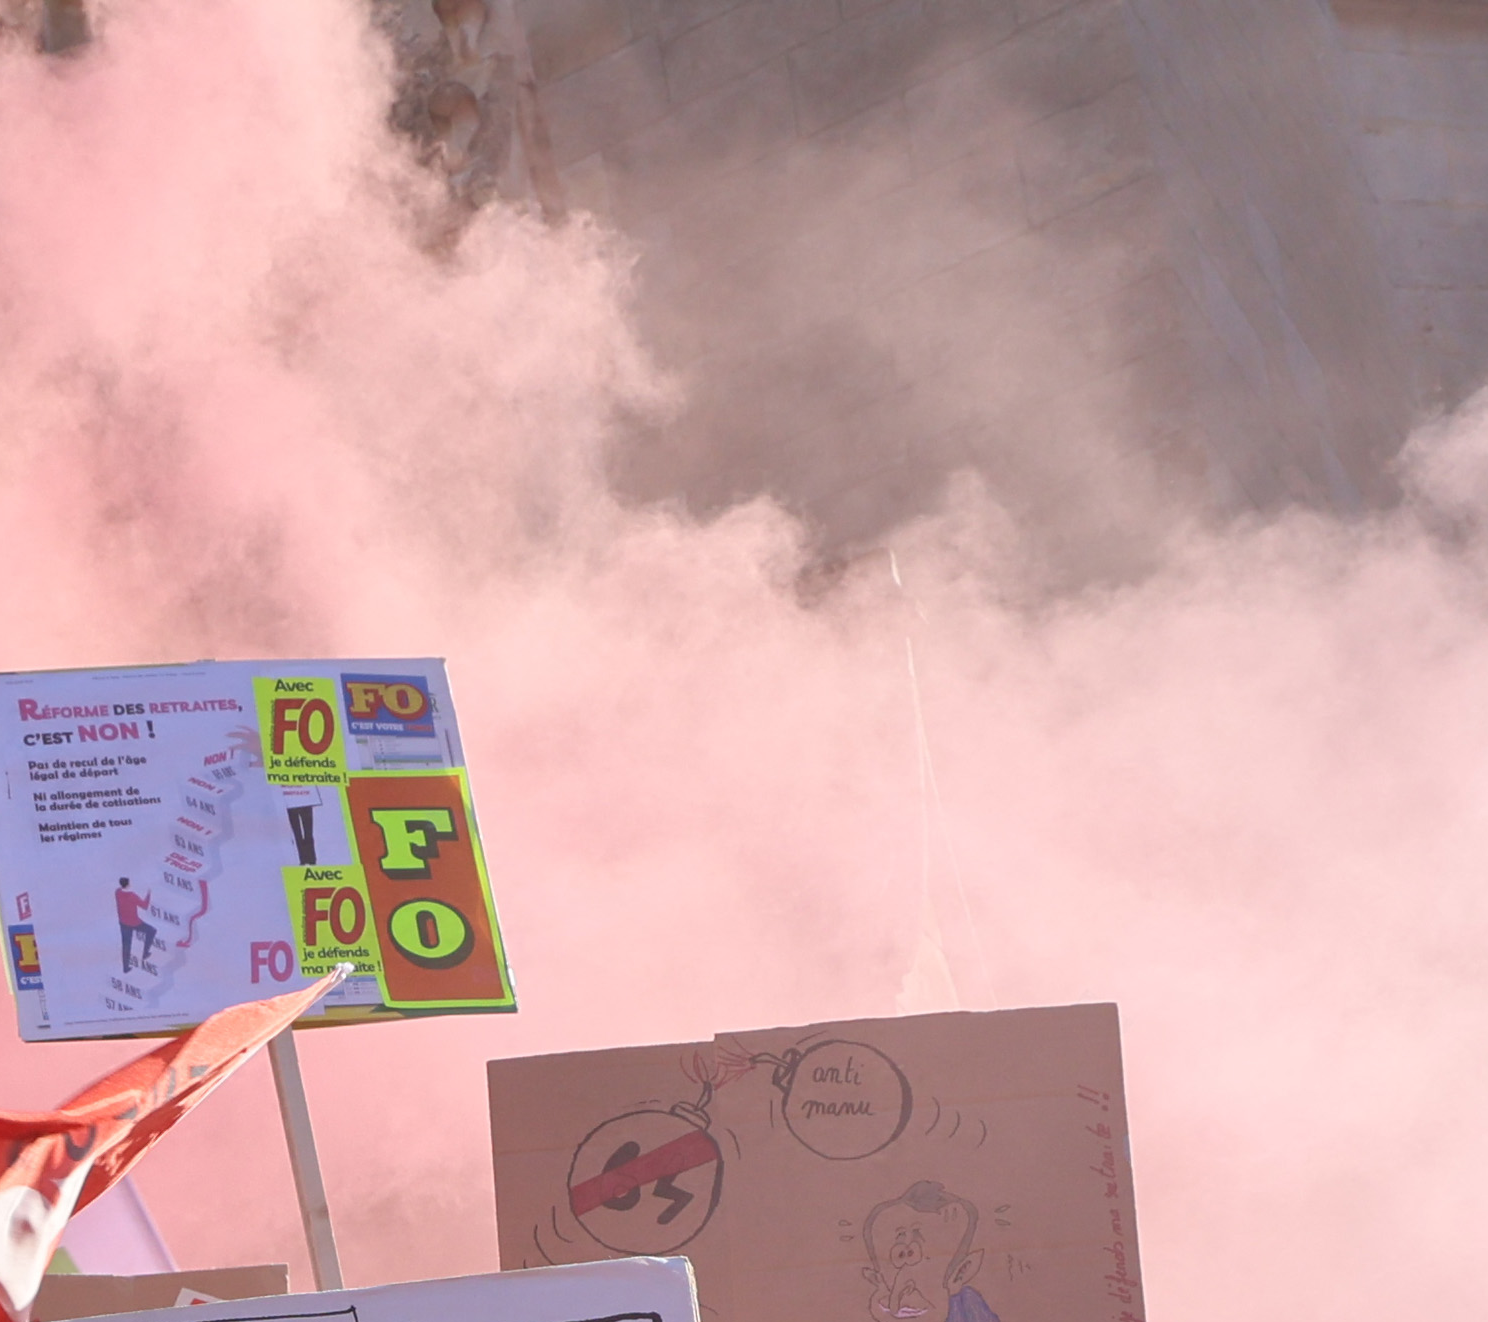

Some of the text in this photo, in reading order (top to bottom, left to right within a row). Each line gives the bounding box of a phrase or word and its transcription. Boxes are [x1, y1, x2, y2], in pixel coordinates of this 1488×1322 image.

[275, 679, 314, 692] Avec
[113, 703, 144, 715] DES
[150, 699, 243, 714] RETRAITES,
[346, 682, 428, 720] FO
[77, 722, 139, 742] NON
[146, 721, 155, 738] !
[273, 698, 334, 755] FO
[28, 760, 49, 770] Pas
[53, 759, 66, 769] de
[69, 758, 98, 768] recul
[101, 757, 114, 766] de
[203, 752, 227, 766] NON
[270, 757, 336, 769] je défends
[29, 767, 118, 781] légal de départ
[268, 772, 347, 783] ma retraite !
[187, 776, 214, 792] NON
[33, 787, 140, 803] Ni allongement de
[35, 796, 161, 812] la durée de cotisations
[199, 800, 216, 816] ANS
[38, 818, 132, 833] Maintien de tous
[177, 816, 203, 831] NON
[40, 830, 102, 843] les régimes
[187, 838, 204, 857] ANS
[163, 872, 194, 891] 62 ANS
[304, 868, 343, 880] Avec
[151, 906, 180, 926] 61 ANS
[305, 887, 366, 946] FO
[250, 941, 294, 983] FO
[303, 947, 369, 961] je défends
[141, 958, 158, 976] ANS
[302, 965, 323, 974] ma
[111, 977, 142, 1000] 58 ANS
[813, 1056, 864, 1085] anti
[801, 1100, 874, 1119] manu
[1112, 1209, 1123, 1235] ma
